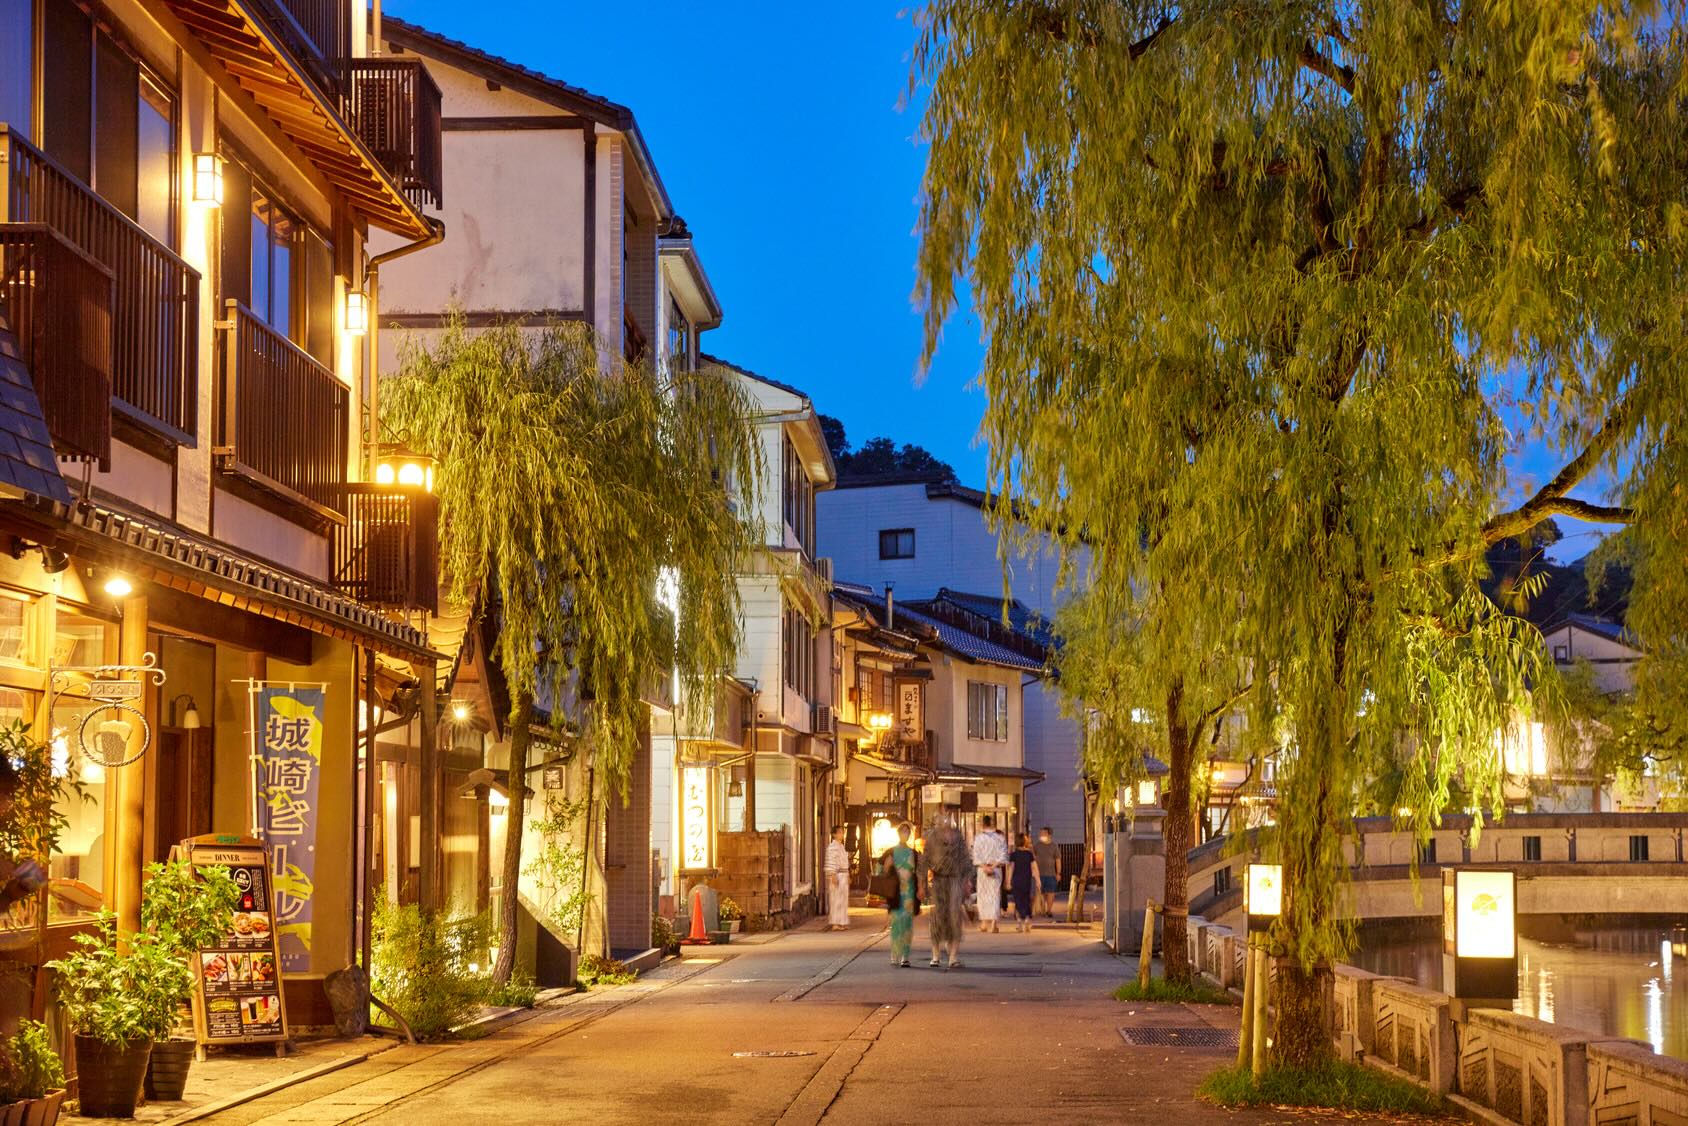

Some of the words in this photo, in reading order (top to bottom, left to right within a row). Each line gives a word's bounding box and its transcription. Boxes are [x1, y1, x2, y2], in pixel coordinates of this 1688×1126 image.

[215, 854, 240, 862] DINNER
[265, 713, 315, 922] 城崎ビール
